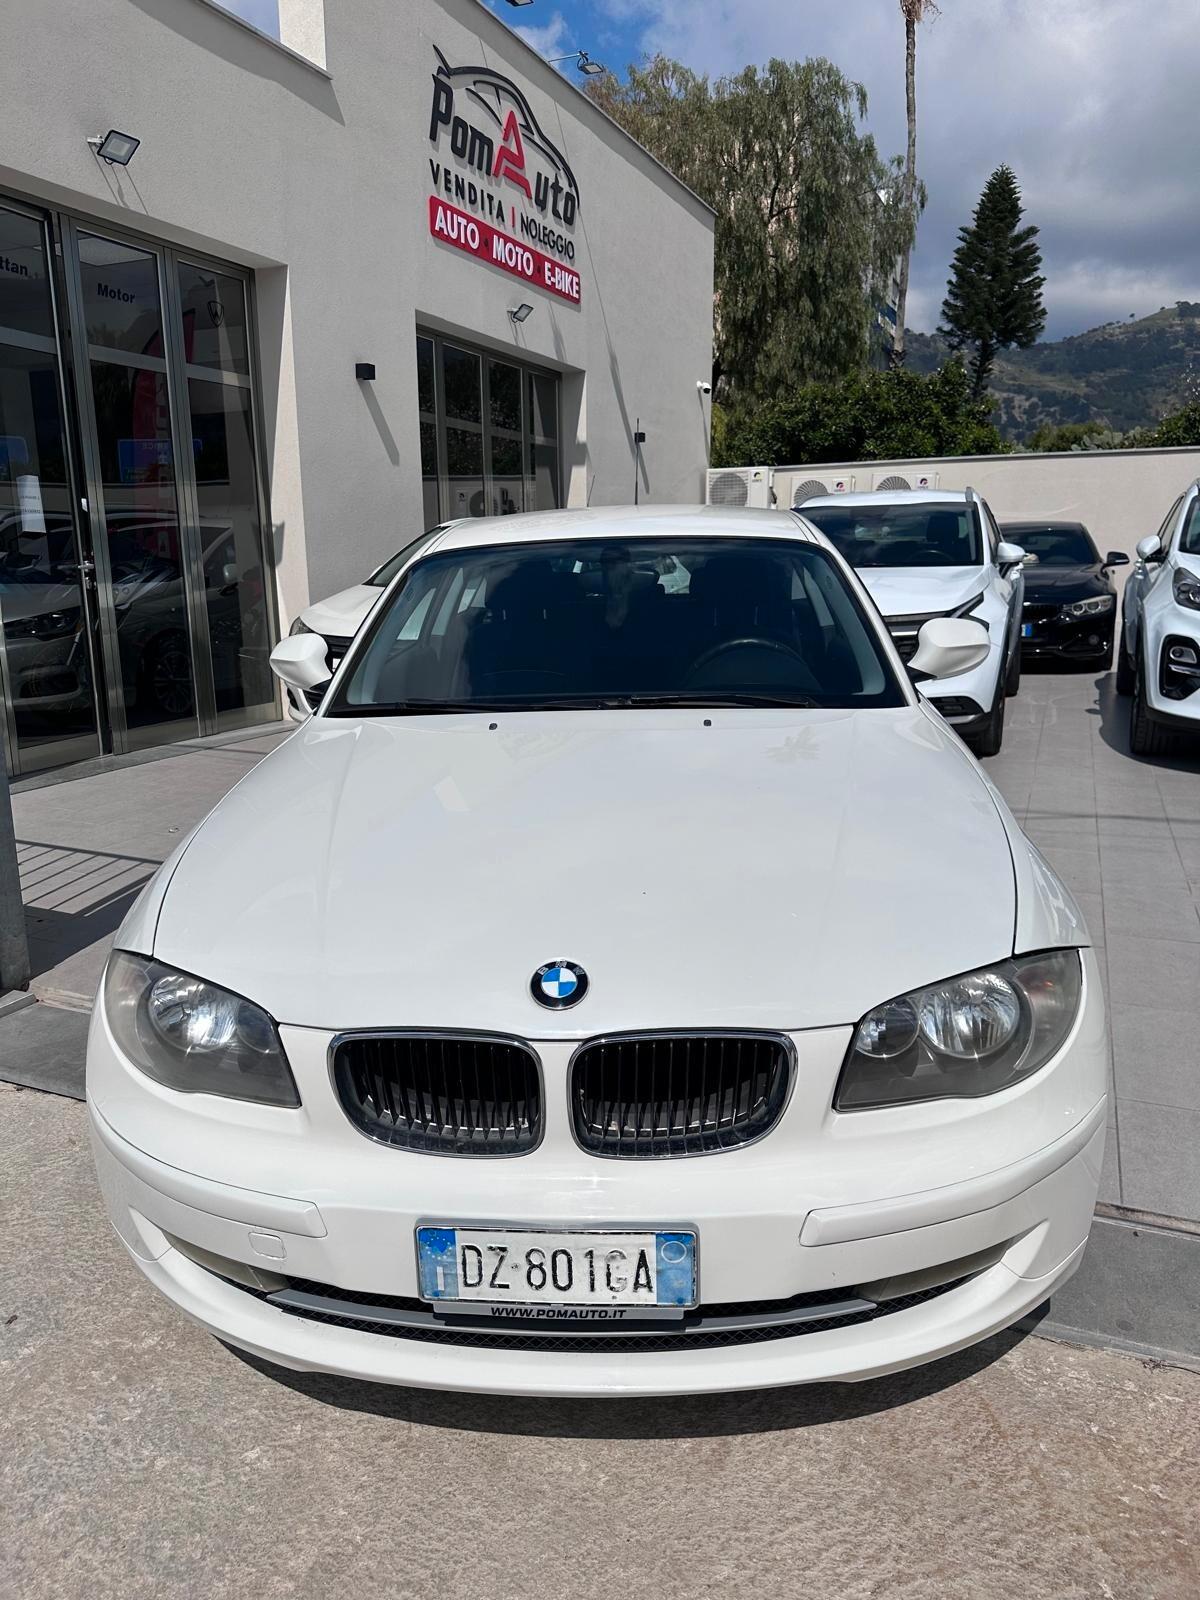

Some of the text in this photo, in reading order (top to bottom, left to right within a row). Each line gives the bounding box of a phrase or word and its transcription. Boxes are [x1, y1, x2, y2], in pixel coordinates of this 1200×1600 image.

[429, 158, 575, 260] VENDITA NOLEGGIO
[434, 206, 580, 299] AUTO MOTO E-BIKE
[97, 283, 136, 304] Motor
[461, 1244, 510, 1290] DZ
[490, 1306, 627, 1319] WWW.POMAUTO.IT
